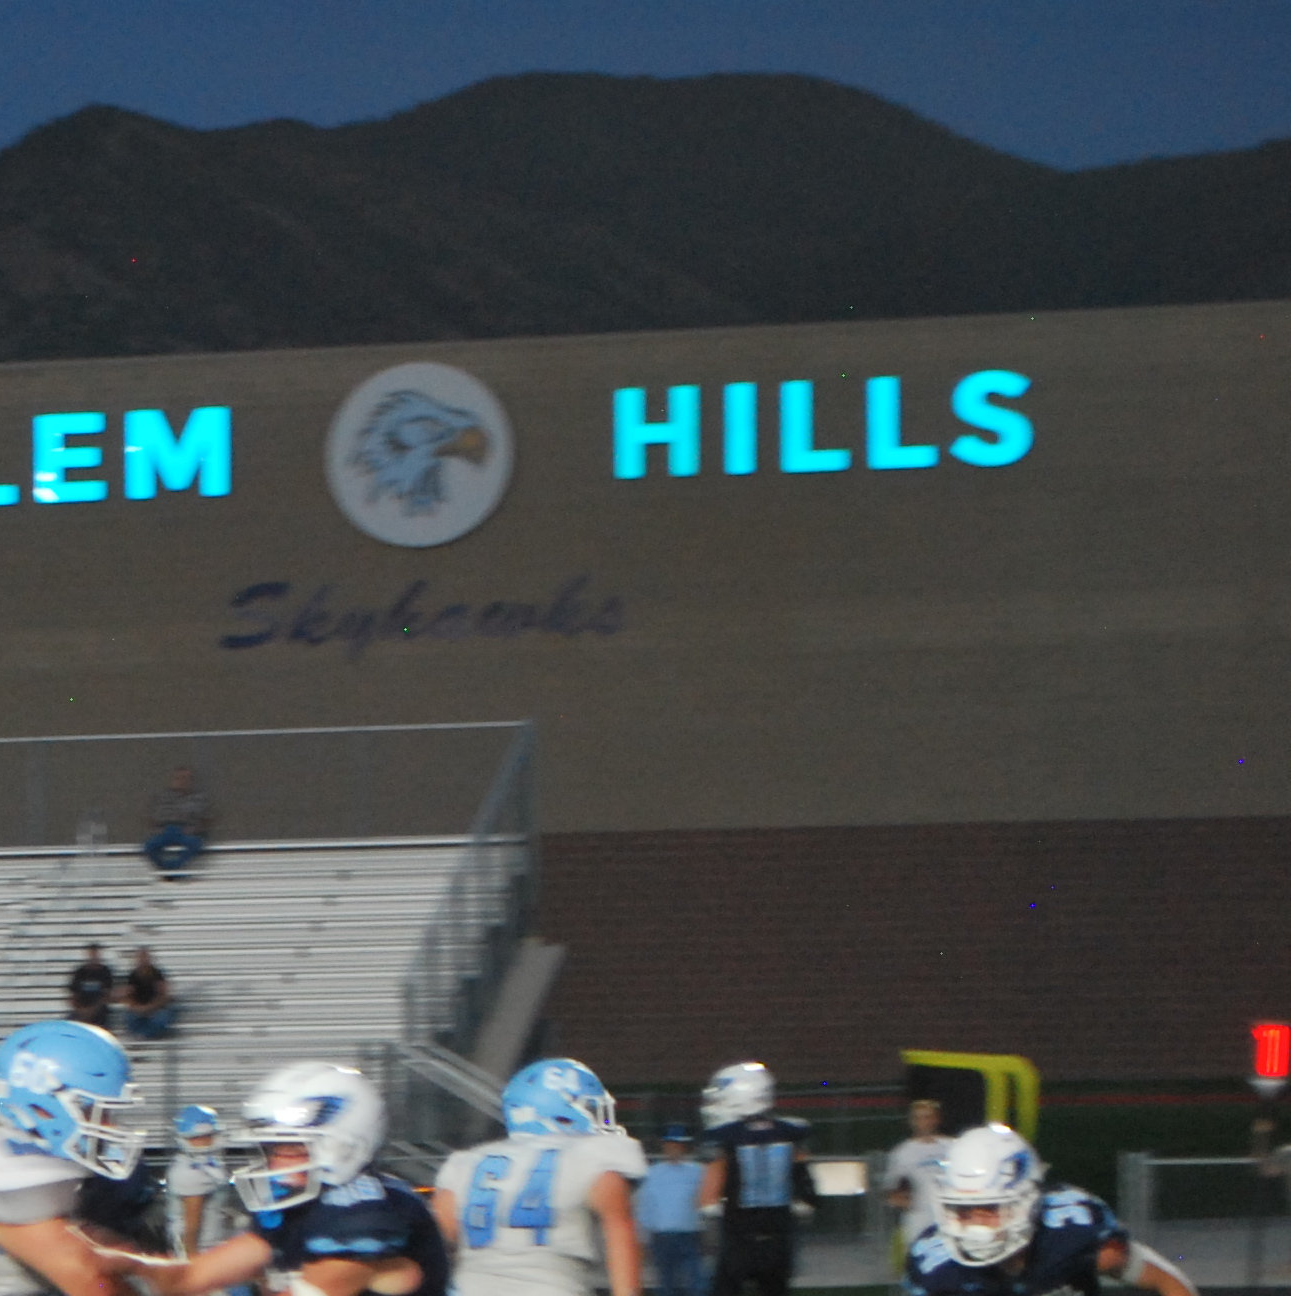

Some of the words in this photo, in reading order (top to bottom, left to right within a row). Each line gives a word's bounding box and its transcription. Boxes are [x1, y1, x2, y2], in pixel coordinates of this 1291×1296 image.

[612, 369, 1034, 481] HILLS
[219, 574, 627, 660] Skyhawks
[463, 1148, 559, 1250] 64
